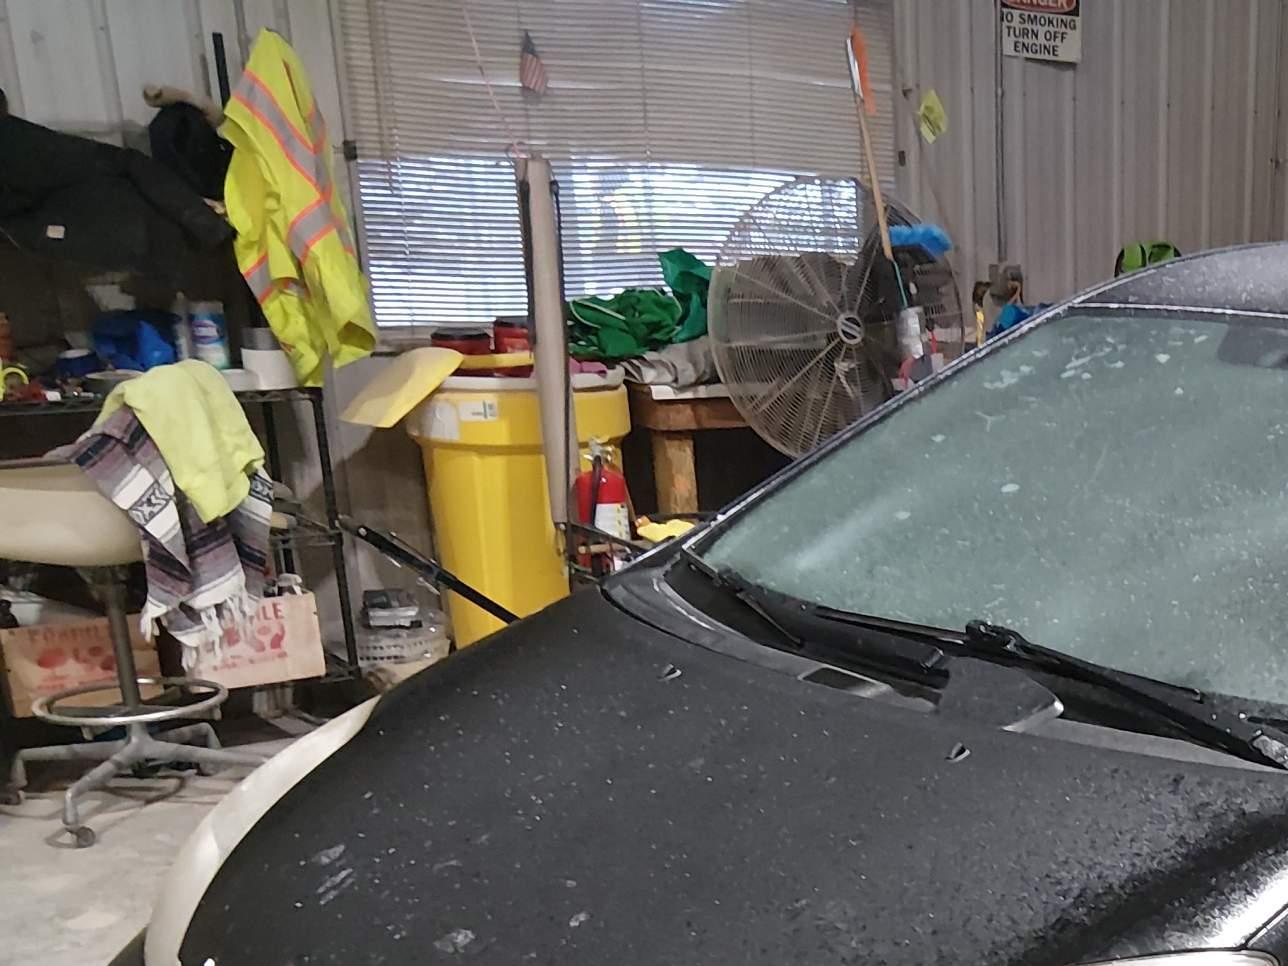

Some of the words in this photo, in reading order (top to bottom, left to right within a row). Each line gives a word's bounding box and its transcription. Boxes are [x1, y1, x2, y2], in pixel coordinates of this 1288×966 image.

[1018, 13, 1077, 30] SMOKING
[1006, 25, 1039, 41] TURN
[1044, 30, 1068, 43] OFF
[1013, 41, 1059, 57] ENGINE
